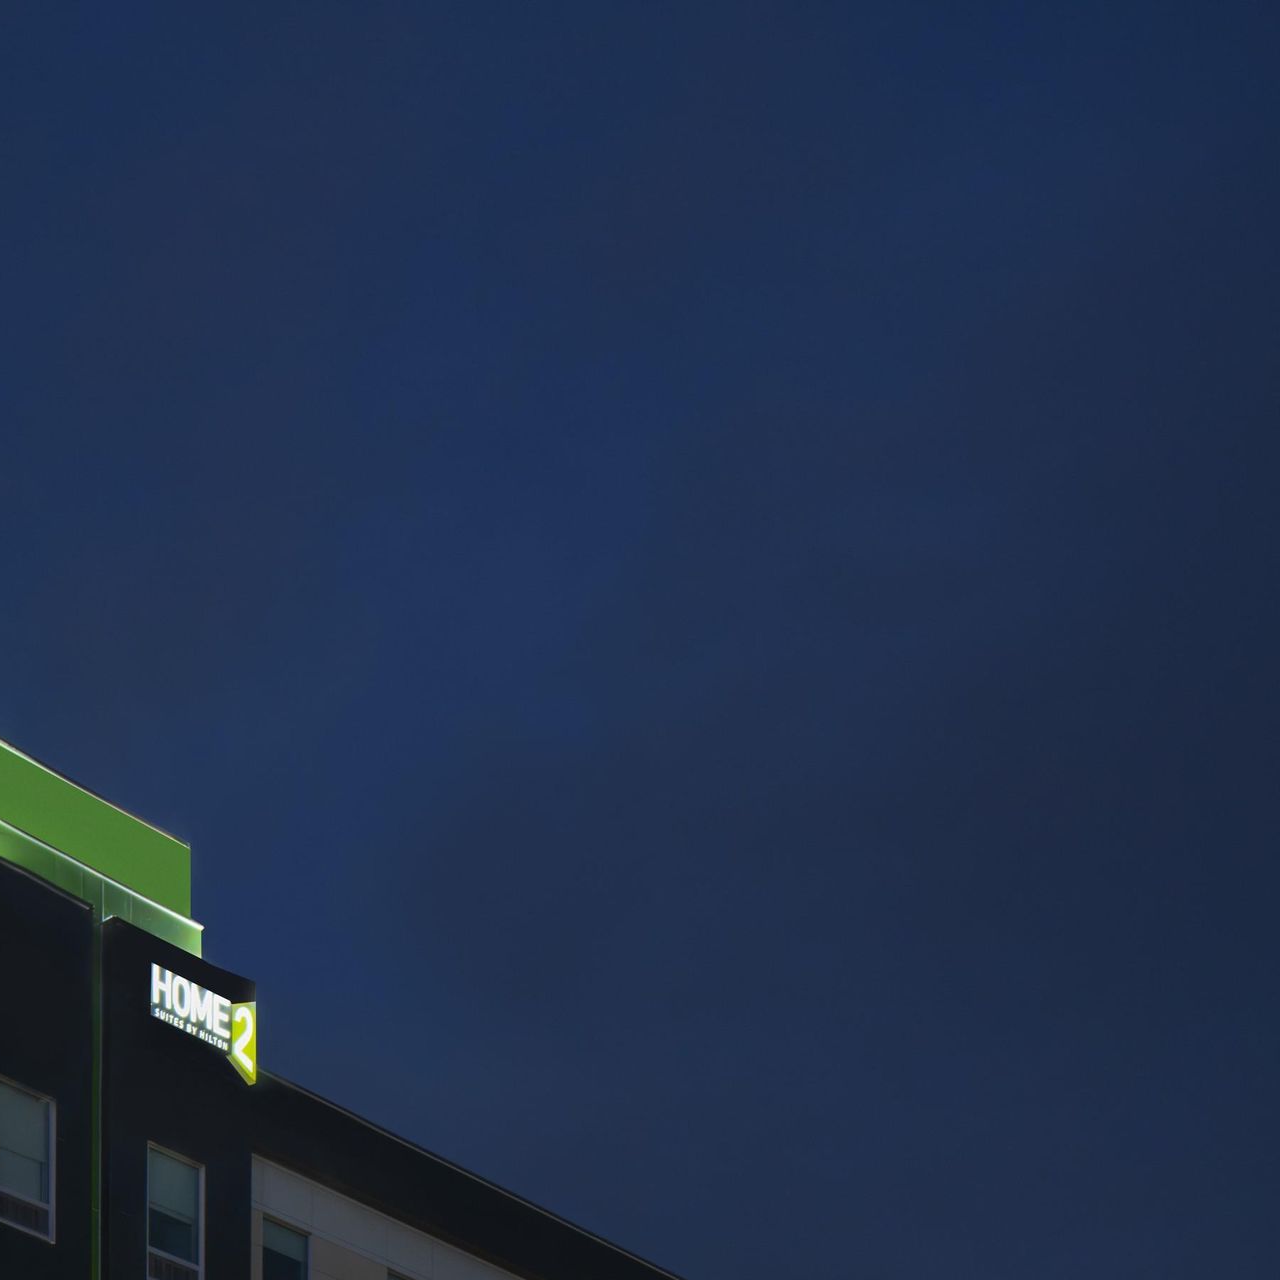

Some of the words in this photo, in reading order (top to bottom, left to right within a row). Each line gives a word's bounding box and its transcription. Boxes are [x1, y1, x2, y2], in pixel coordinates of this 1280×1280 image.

[151, 962, 232, 1039] HOME
[155, 1008, 184, 1029] SUITES
[186, 1023, 198, 1035] BY
[199, 1029, 228, 1051] HILTON
